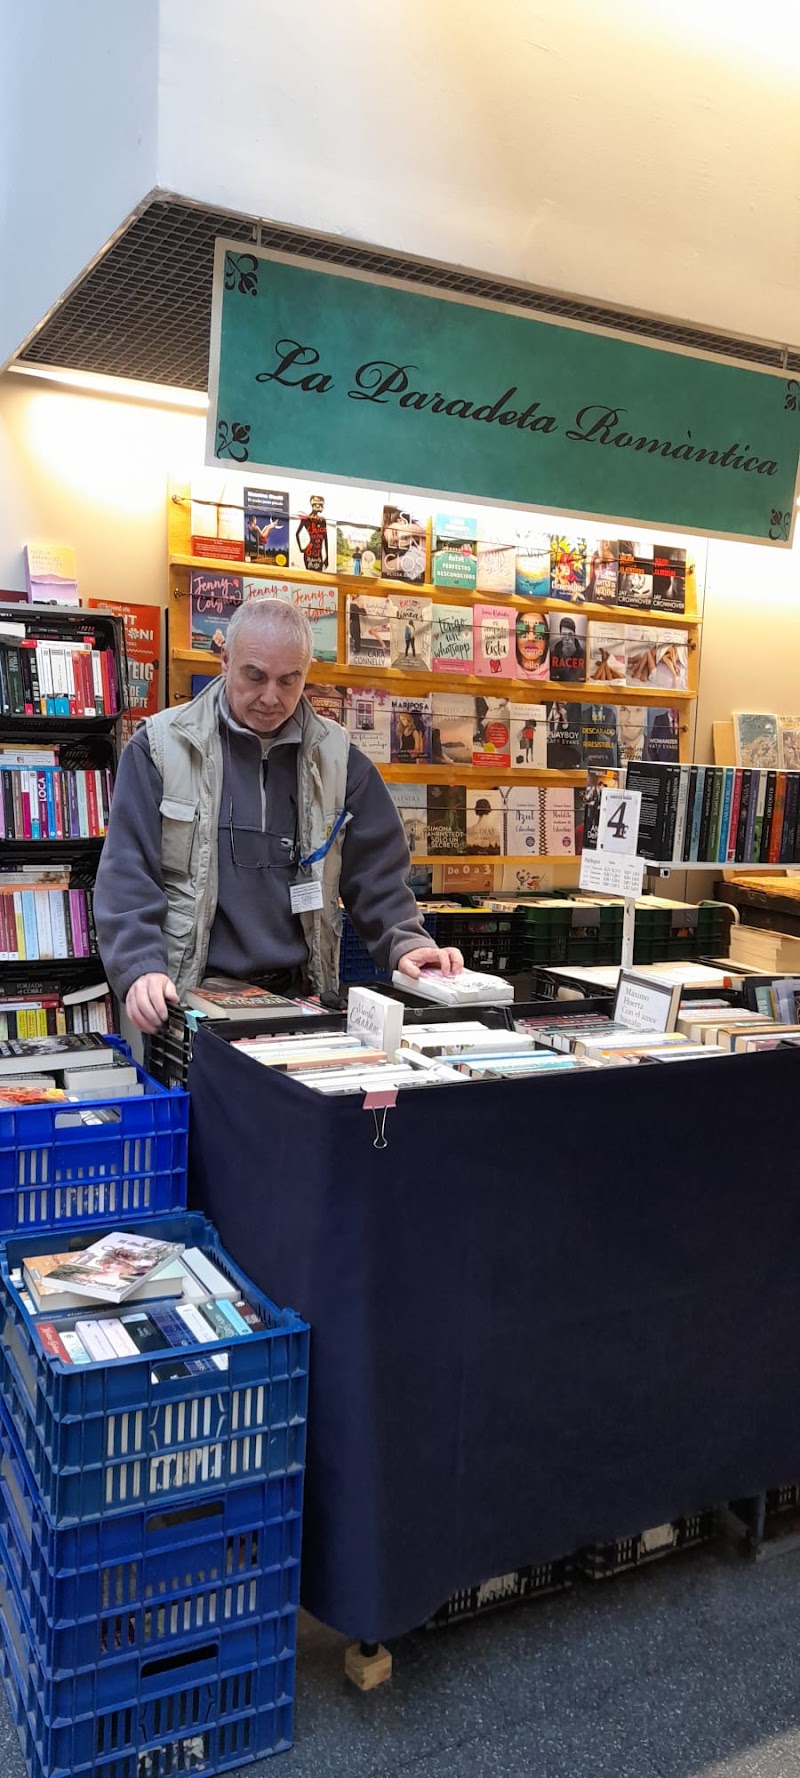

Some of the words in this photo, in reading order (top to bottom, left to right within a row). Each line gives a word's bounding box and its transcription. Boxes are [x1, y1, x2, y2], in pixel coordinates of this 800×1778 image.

[255, 338, 334, 394] La
[348, 360, 559, 435] Paradeta
[566, 404, 778, 477] Romàntica
[387, 531, 422, 552] LEN
[384, 553, 424, 572] CIOS
[437, 570, 476, 580] DESCONOCIDOS
[193, 576, 232, 596] Jenny
[245, 583, 282, 601] Jenny
[197, 590, 241, 613] Colgan
[292, 588, 328, 608] Jenny
[618, 596, 652, 606] CROWNOVER
[653, 600, 684, 609] CROWNOVER
[367, 649, 385, 658] CARA
[434, 642, 471, 659] whatsapp
[485, 641, 506, 657] lista
[354, 656, 386, 666] CONNELLY
[551, 656, 585, 669] RACER
[391, 701, 429, 711] MARIPOSA
[547, 731, 579, 740] PLAYBOY
[582, 727, 616, 736] DESCARADO
[582, 741, 615, 749] IRRESISTIBLE
[38, 778, 47, 802] LOCA
[447, 866, 460, 875] De
[483, 865, 492, 875] 3
[625, 987, 650, 1001] Máximo
[623, 996, 644, 1011] Huerta
[621, 1005, 634, 1017] Con
[634, 1010, 641, 1019] el
[641, 1014, 658, 1024] amor
